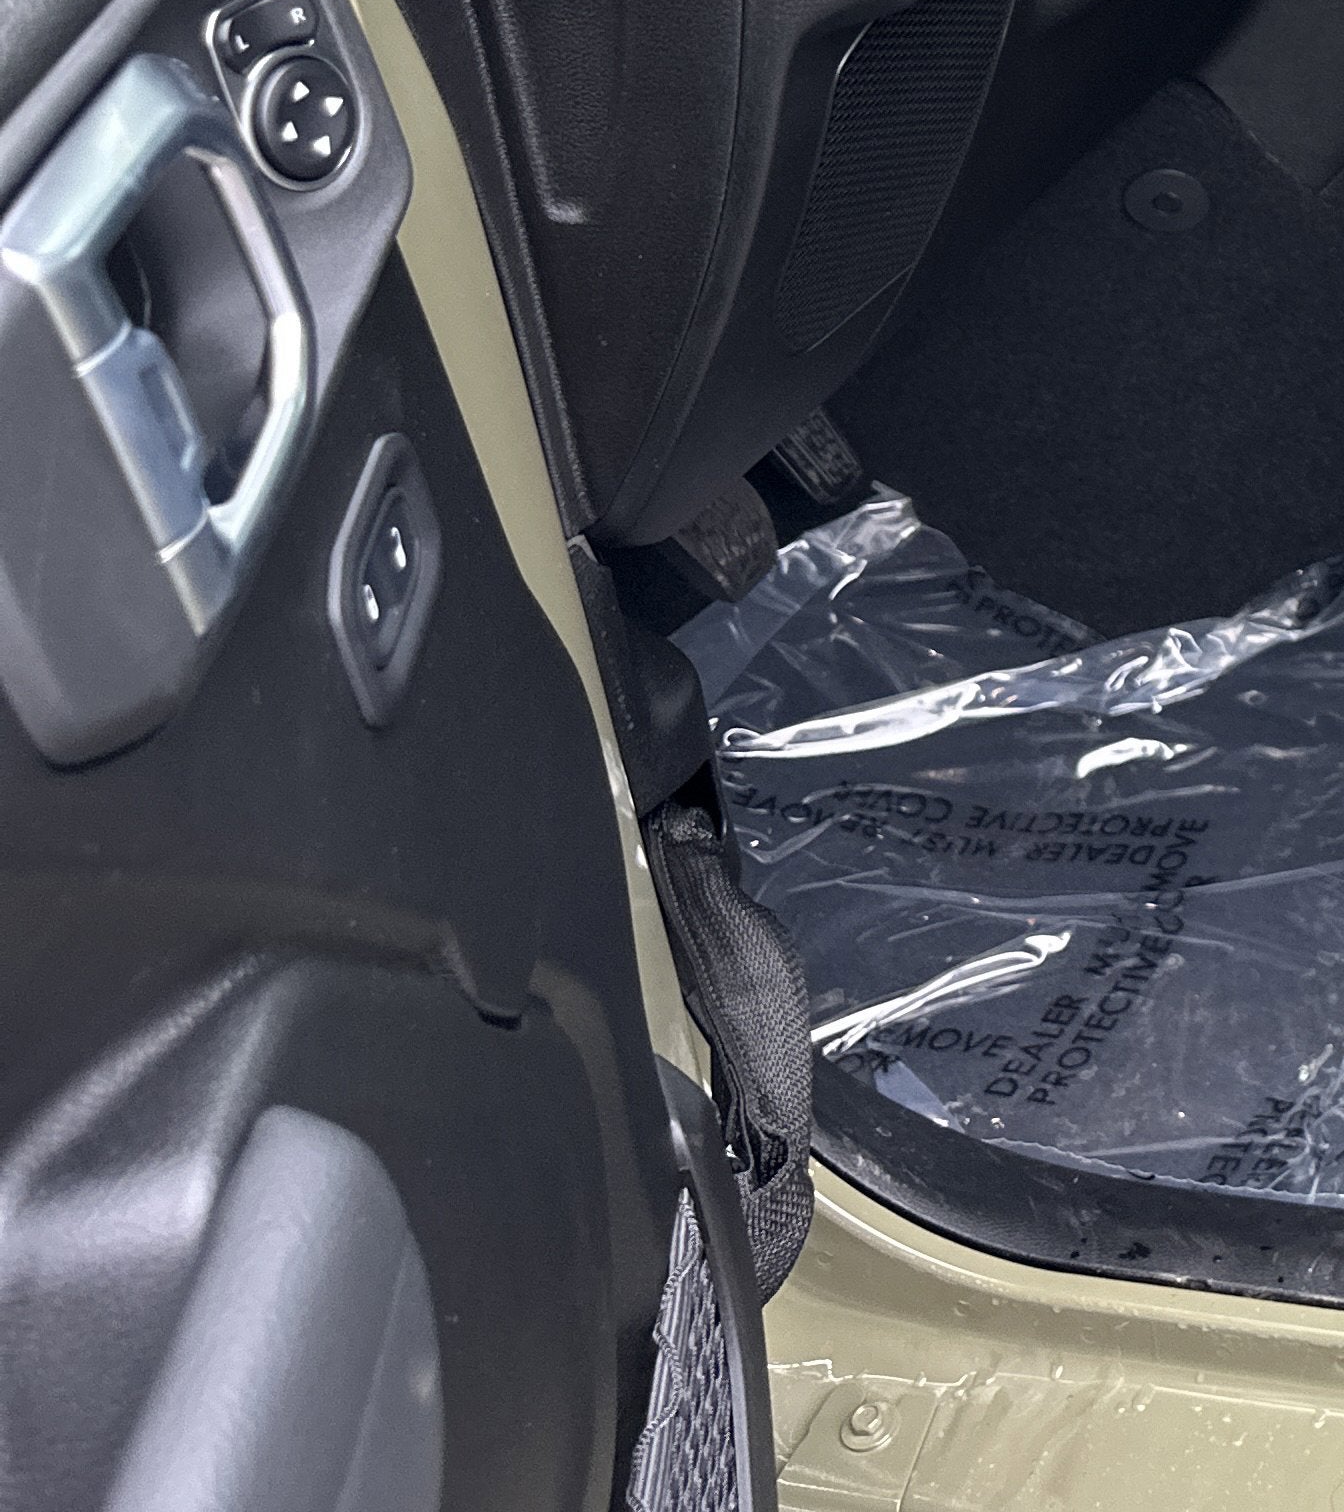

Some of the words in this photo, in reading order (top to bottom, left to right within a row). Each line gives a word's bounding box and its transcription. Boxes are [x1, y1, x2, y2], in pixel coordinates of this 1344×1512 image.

[289, 6, 307, 24] R
[234, 34, 250, 52] L
[983, 991, 1090, 1099] DEALER
